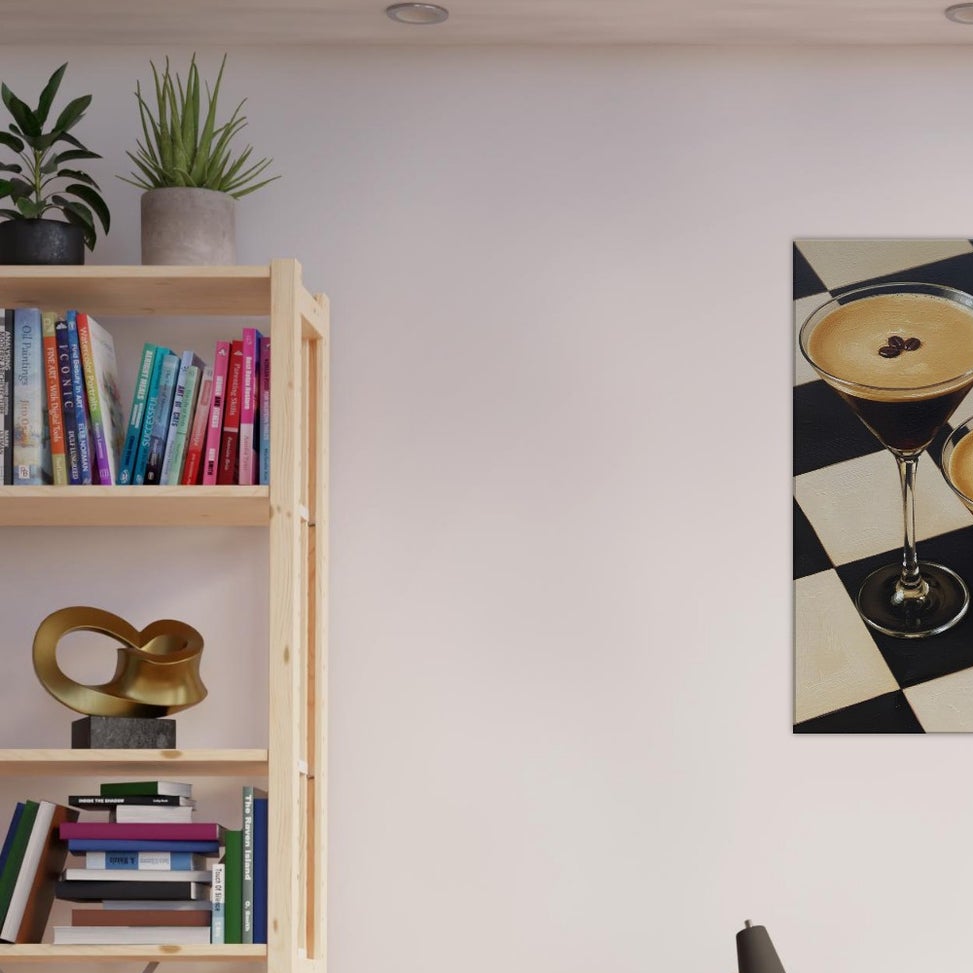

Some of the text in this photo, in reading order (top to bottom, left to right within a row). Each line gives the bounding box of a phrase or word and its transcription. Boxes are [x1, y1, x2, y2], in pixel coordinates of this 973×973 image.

[18, 325, 32, 386] Oil Paintings
[73, 359, 81, 384] Beauty
[80, 326, 97, 411] Watercolor Portraits
[49, 364, 57, 380] ART
[59, 344, 73, 409] ICONIC
[50, 385, 59, 402] With
[228, 363, 240, 416] Parenting Skills
[50, 402, 61, 426] Digital
[142, 397, 157, 447] SUCCESSFUL
[52, 427, 61, 442] Tools
[79, 440, 89, 472] NORMAN
[244, 794, 252, 880] The Raven Island
[214, 868, 222, 883] Touch
